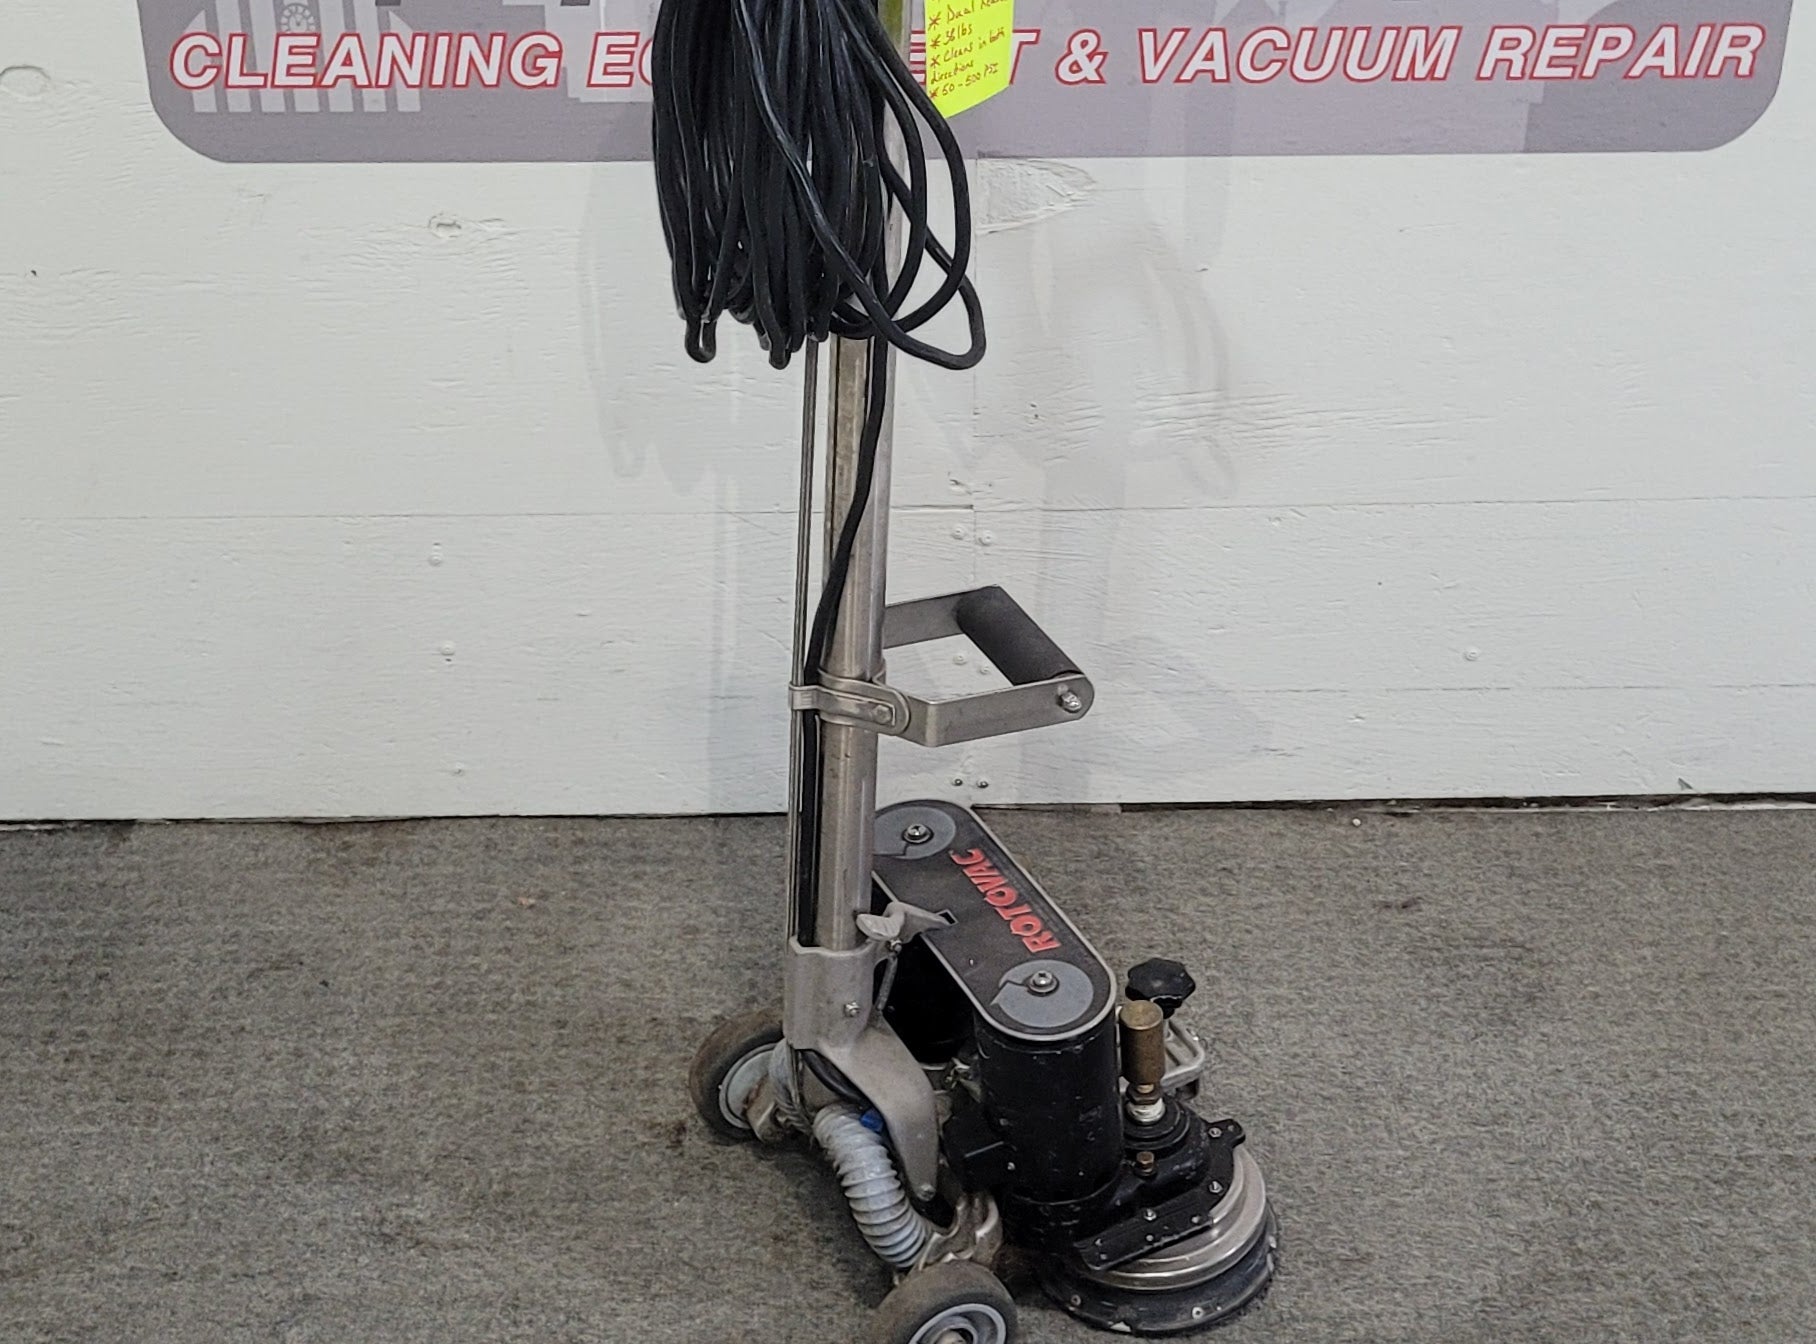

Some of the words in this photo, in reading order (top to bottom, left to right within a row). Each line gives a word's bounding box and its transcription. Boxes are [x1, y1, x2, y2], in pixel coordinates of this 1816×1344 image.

[946, 0, 975, 24] Dual
[169, 31, 563, 90] CLEANING
[1055, 27, 1108, 85] &
[1137, 26, 1456, 84] VACUUM
[1496, 22, 1768, 81] REPAIR
[948, 847, 1062, 954] ROTOVAC
